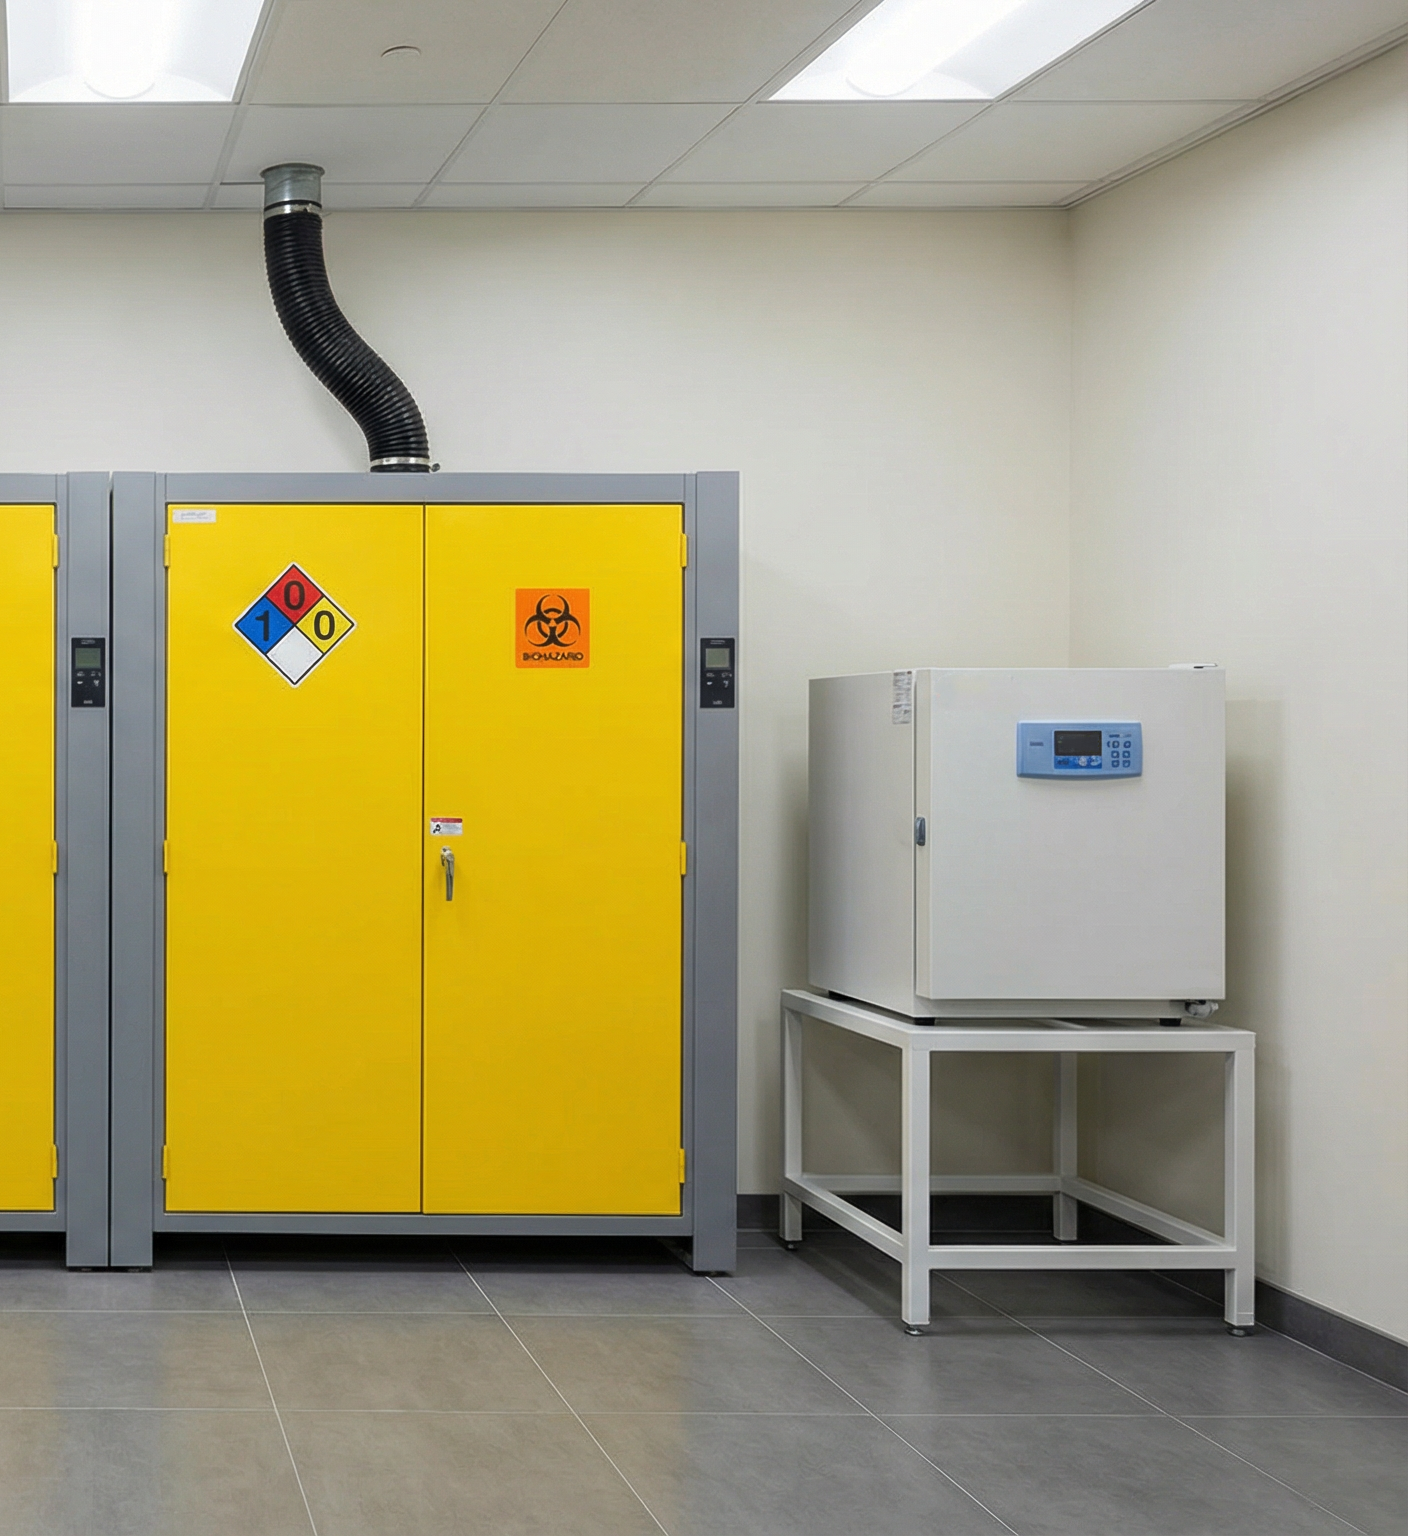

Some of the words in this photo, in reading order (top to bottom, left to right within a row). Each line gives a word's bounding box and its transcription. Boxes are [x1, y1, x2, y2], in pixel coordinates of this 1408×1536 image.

[283, 580, 306, 611] 0
[255, 610, 270, 642] 1
[313, 610, 335, 641] 0
